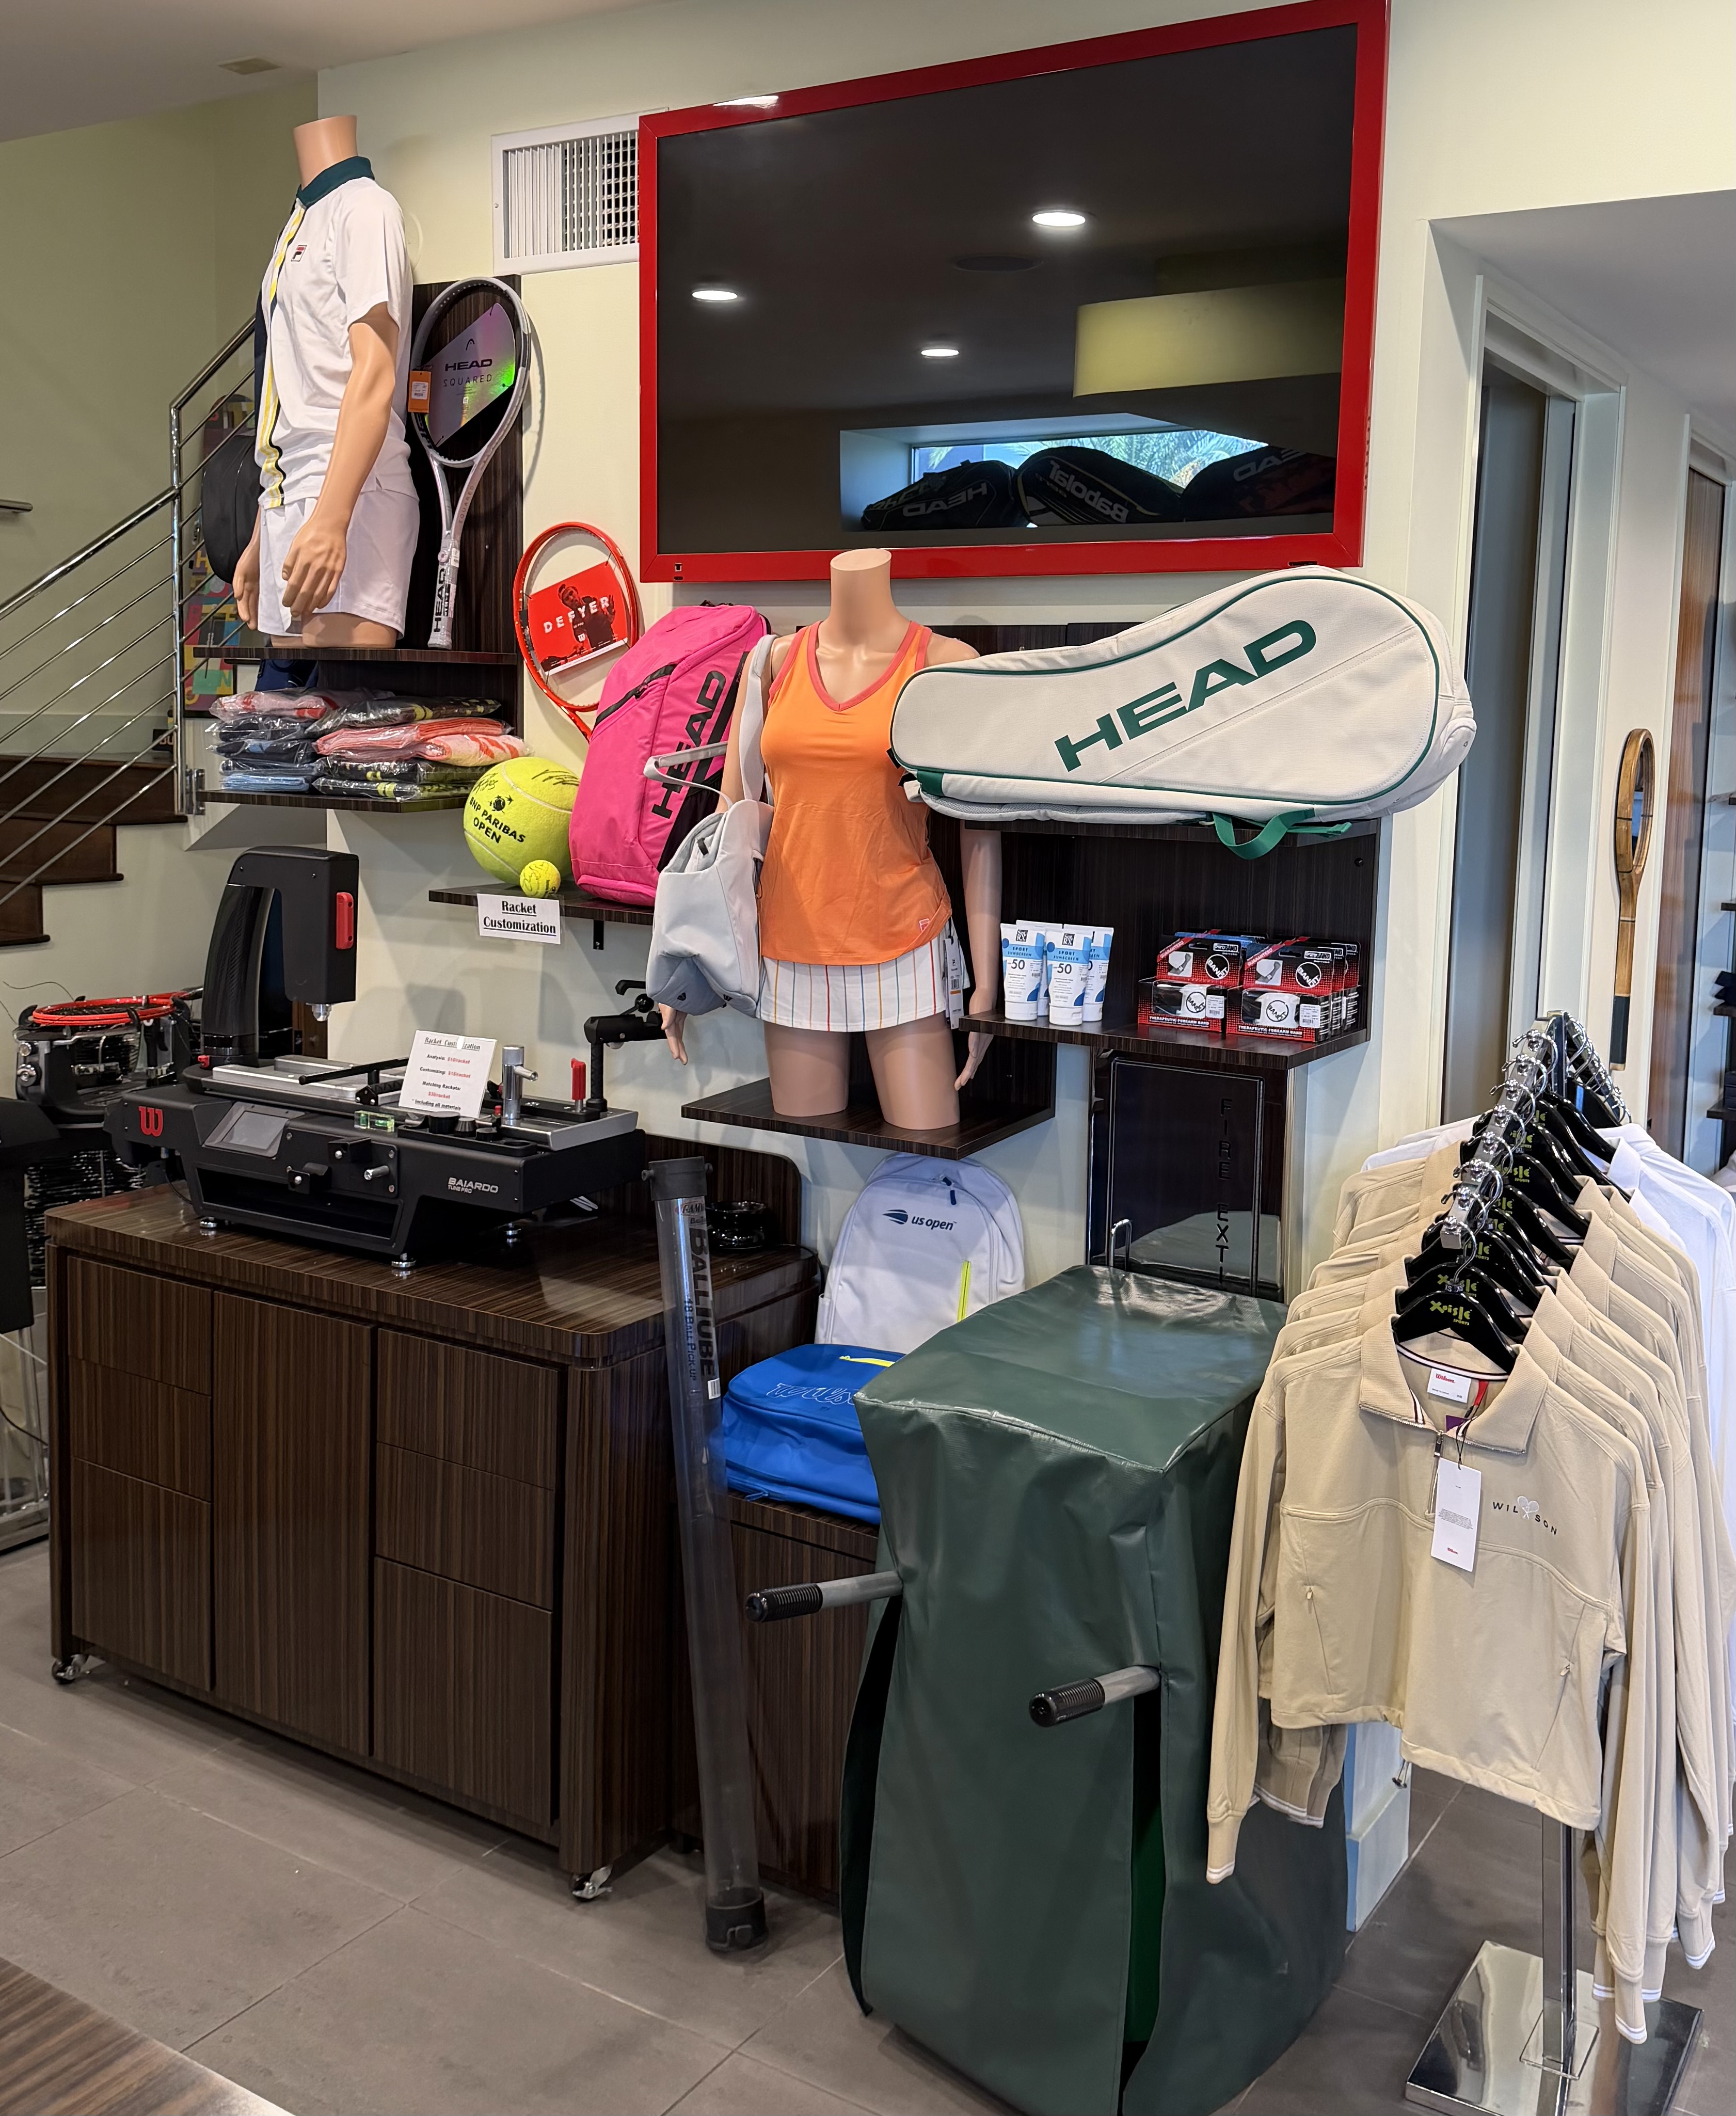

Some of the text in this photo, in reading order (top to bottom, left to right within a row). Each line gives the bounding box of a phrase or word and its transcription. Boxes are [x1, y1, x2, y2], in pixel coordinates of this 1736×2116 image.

[445, 359, 492, 372] HEAD
[443, 374, 492, 387] SQUARED
[434, 568, 445, 632] HEAD
[543, 596, 610, 633] DEFYER
[1054, 619, 1316, 773] HEAD
[651, 671, 726, 819] HEAD
[469, 797, 526, 842] BNP PARIBAS
[473, 817, 502, 844] OPEN
[502, 901, 537, 914] Racket
[483, 916, 556, 934] Customization
[1011, 959, 1025, 969] 50
[1057, 963, 1072, 974] 50
[444, 1039, 480, 1050] Custzation
[1219, 1098, 1232, 1180] FIRE
[448, 1177, 499, 1193] BAIARDO
[912, 1216, 954, 1231] us open
[1436, 1373, 1455, 1383] Wilson
